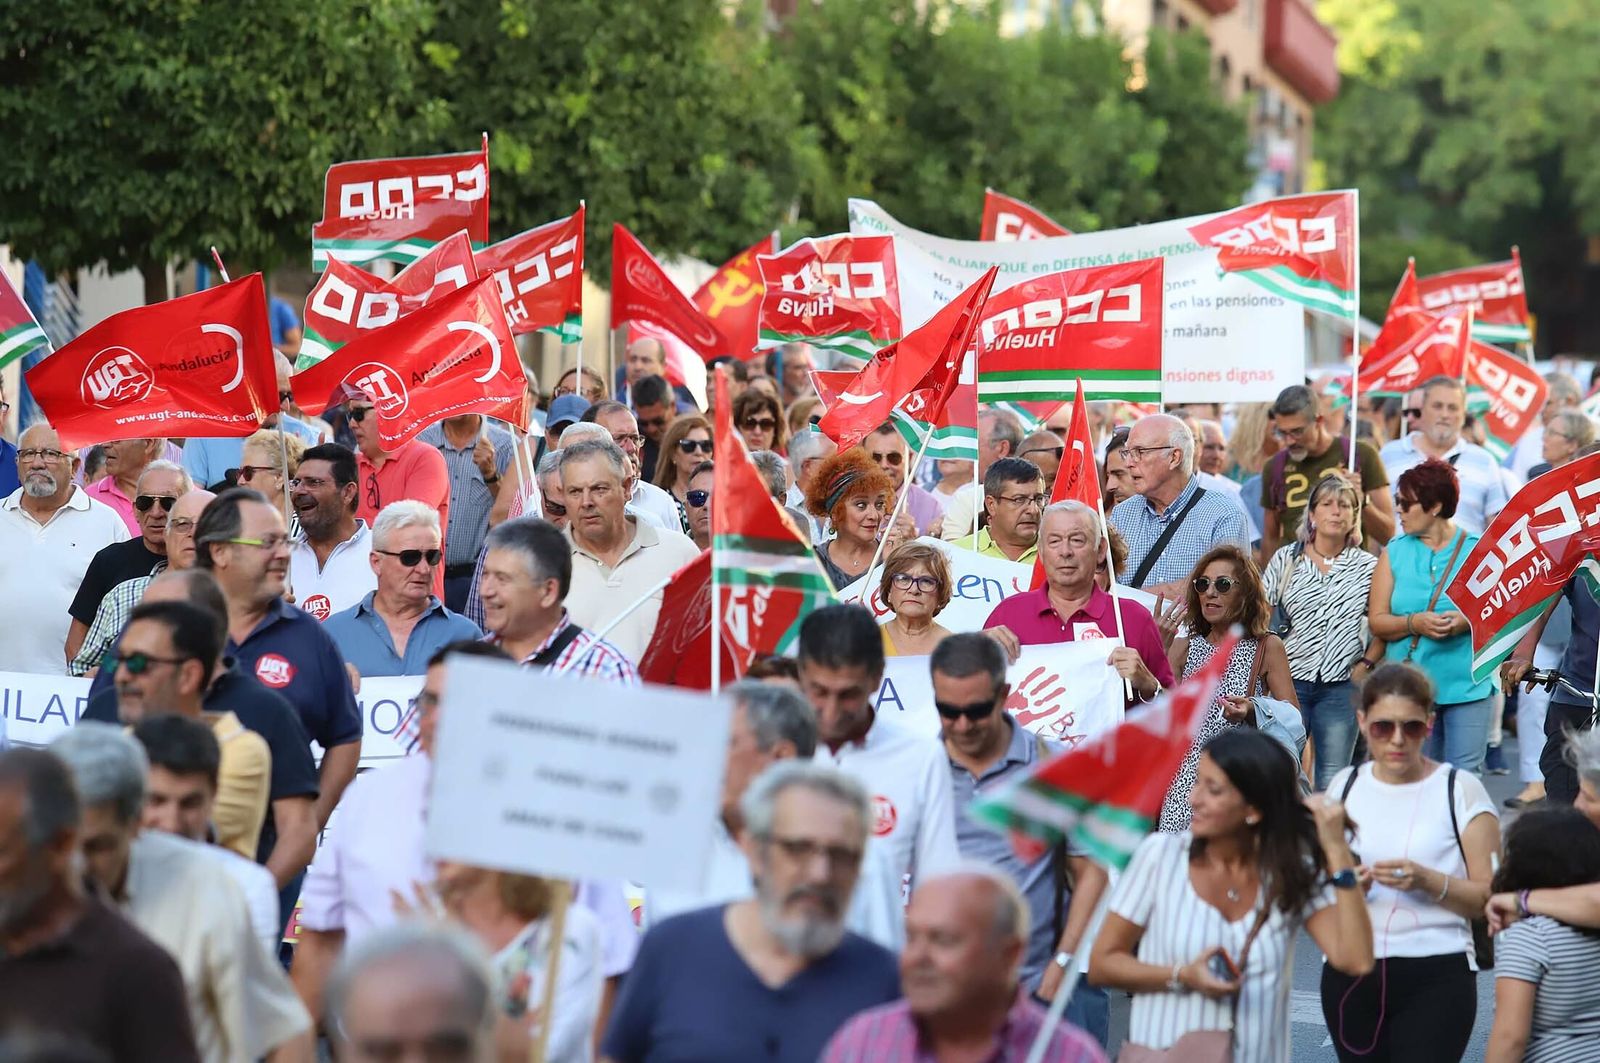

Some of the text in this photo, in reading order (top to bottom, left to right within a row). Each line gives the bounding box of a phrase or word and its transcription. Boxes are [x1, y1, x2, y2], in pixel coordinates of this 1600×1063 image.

[1032, 263, 1049, 273] en
[1053, 253, 1114, 271] DEFENSA
[1117, 250, 1134, 263] de
[1191, 295, 1212, 308] las
[1215, 293, 1285, 310] pensiones
[1173, 323, 1227, 338] mañana
[87, 354, 140, 400] UGT
[1167, 367, 1275, 385] nsiones dignas
[305, 598, 329, 614] UGT
[258, 656, 290, 677] UGT
